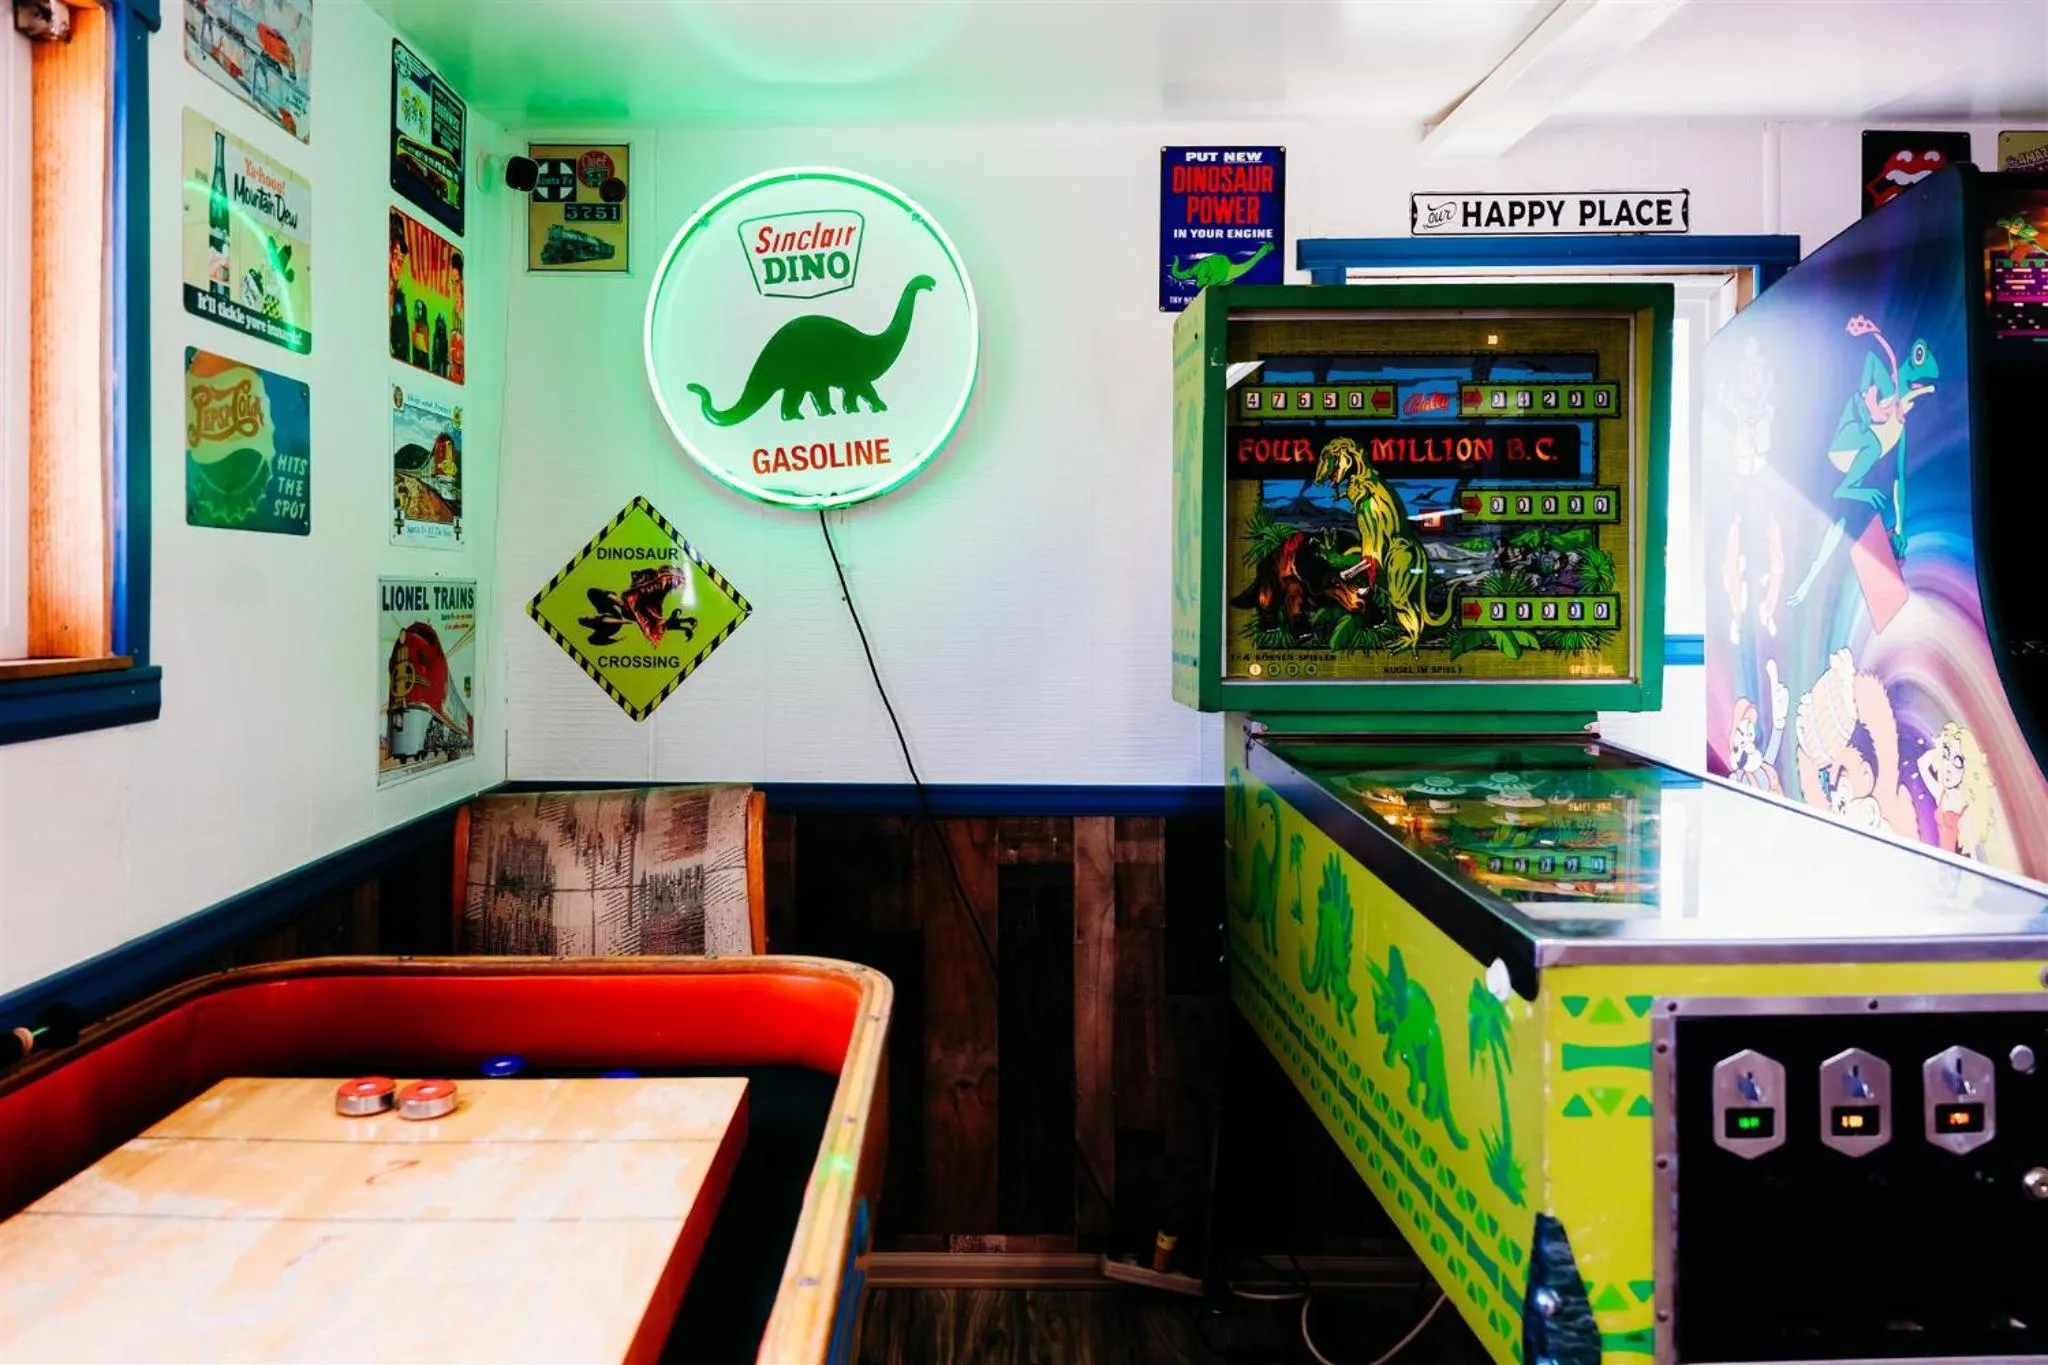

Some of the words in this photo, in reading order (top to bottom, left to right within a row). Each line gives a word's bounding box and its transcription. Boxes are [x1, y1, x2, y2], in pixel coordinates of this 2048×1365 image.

[1185, 152, 1218, 162] PUT
[1224, 152, 1263, 162] NEW
[1172, 165, 1274, 194] DINOSAUR
[275, 193, 298, 230] Dew
[1186, 195, 1261, 225] POWER
[1424, 201, 1457, 226] our
[1462, 200, 1565, 227] HAPPY
[1579, 199, 1672, 226] PLACE
[755, 222, 856, 254] Sinclair
[1173, 229, 1187, 239] IN
[1190, 229, 1224, 239] YOUR
[1227, 228, 1273, 239] ENGINE
[762, 250, 850, 285] DINO
[218, 302, 245, 324] tickle
[752, 438, 892, 475] GASOLINE
[1237, 437, 1316, 463] FOUR
[1370, 437, 1494, 463] MILLION
[1505, 437, 1558, 461] B.C.
[277, 453, 308, 476] HITS
[278, 476, 303, 497] THE
[273, 499, 306, 520] SPOT
[597, 547, 678, 561] DINOSAUR
[382, 585, 430, 611] LIONEL
[434, 586, 474, 610] TRAINS
[597, 655, 680, 669] CROSSING
